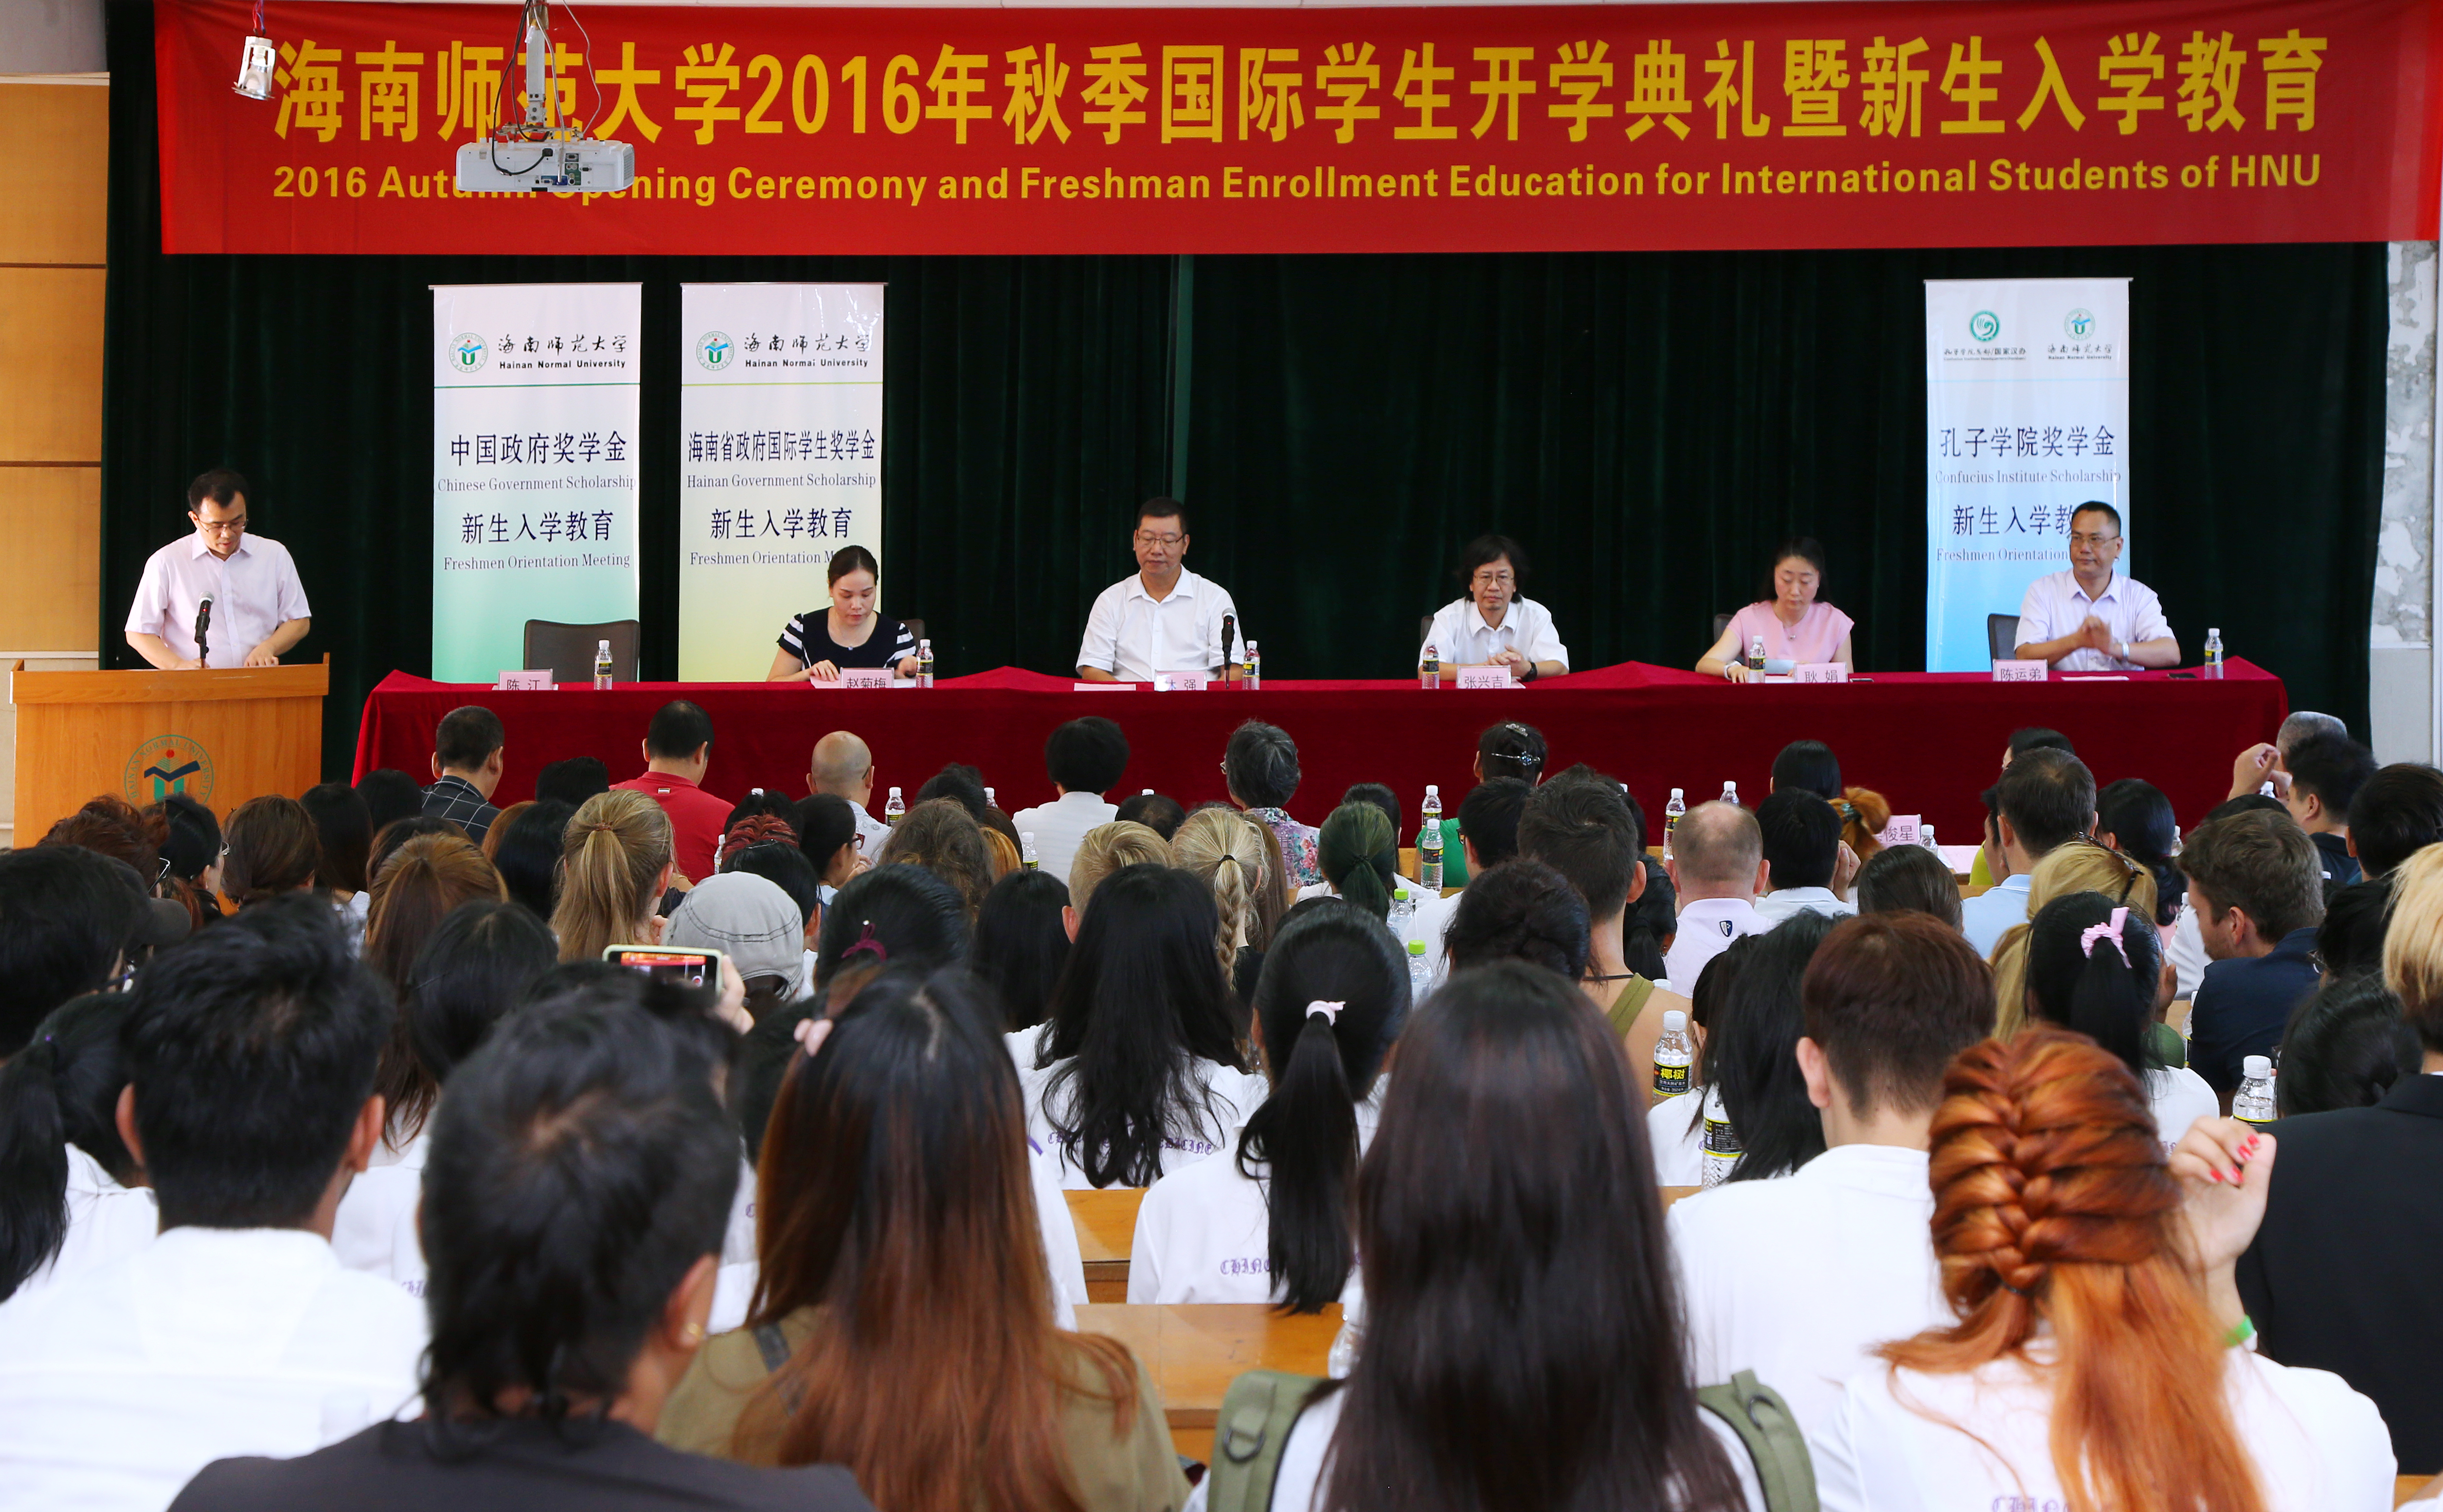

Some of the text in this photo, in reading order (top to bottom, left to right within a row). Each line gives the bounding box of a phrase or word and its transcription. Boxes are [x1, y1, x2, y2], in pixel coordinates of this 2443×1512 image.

[273, 166, 367, 197] 2016
[377, 166, 537, 198] Aut
[728, 166, 927, 206] Ceremony
[938, 167, 1008, 199] and
[1021, 167, 1210, 198] Freshman
[1223, 166, 1438, 198] Enrollment
[1450, 164, 1643, 197] Education
[1655, 162, 1710, 195] for
[1722, 160, 1976, 194] International
[1989, 158, 2169, 191] Students
[2181, 155, 2219, 188] of
[2231, 154, 2320, 187] HNU
[498, 334, 627, 356] 海南师范大学
[744, 332, 870, 355] 海南师范大学
[500, 360, 626, 369] Hainan Normal University
[745, 359, 777, 367] Hainan
[821, 358, 868, 368] University
[450, 430, 627, 467] 中国政府奖学金
[688, 429, 875, 462] 海南省政府国际学生奖学金
[1940, 425, 2115, 458] 孔子学院奖学金
[438, 474, 636, 491] Chinese Government Scholarship
[687, 472, 876, 488] Hainan Government Scholarship
[1936, 468, 2121, 484] Confucius Institute Scholarship
[461, 509, 614, 545] 新生入学教育
[710, 506, 852, 540] 新生入学教育
[1953, 504, 2074, 537] 新生入学教
[444, 553, 630, 571] Freshmen Orientation Meeting
[690, 551, 749, 565] Freshmen
[753, 550, 821, 564] Orientation
[1937, 547, 2070, 561] Freshmen Orientation
[2001, 667, 2041, 681] 陈运弟
[1880, 825, 1915, 842] 俊星
[1660, 1067, 1685, 1080] 椰树
[1158, 1137, 1213, 1155] EDICINE
